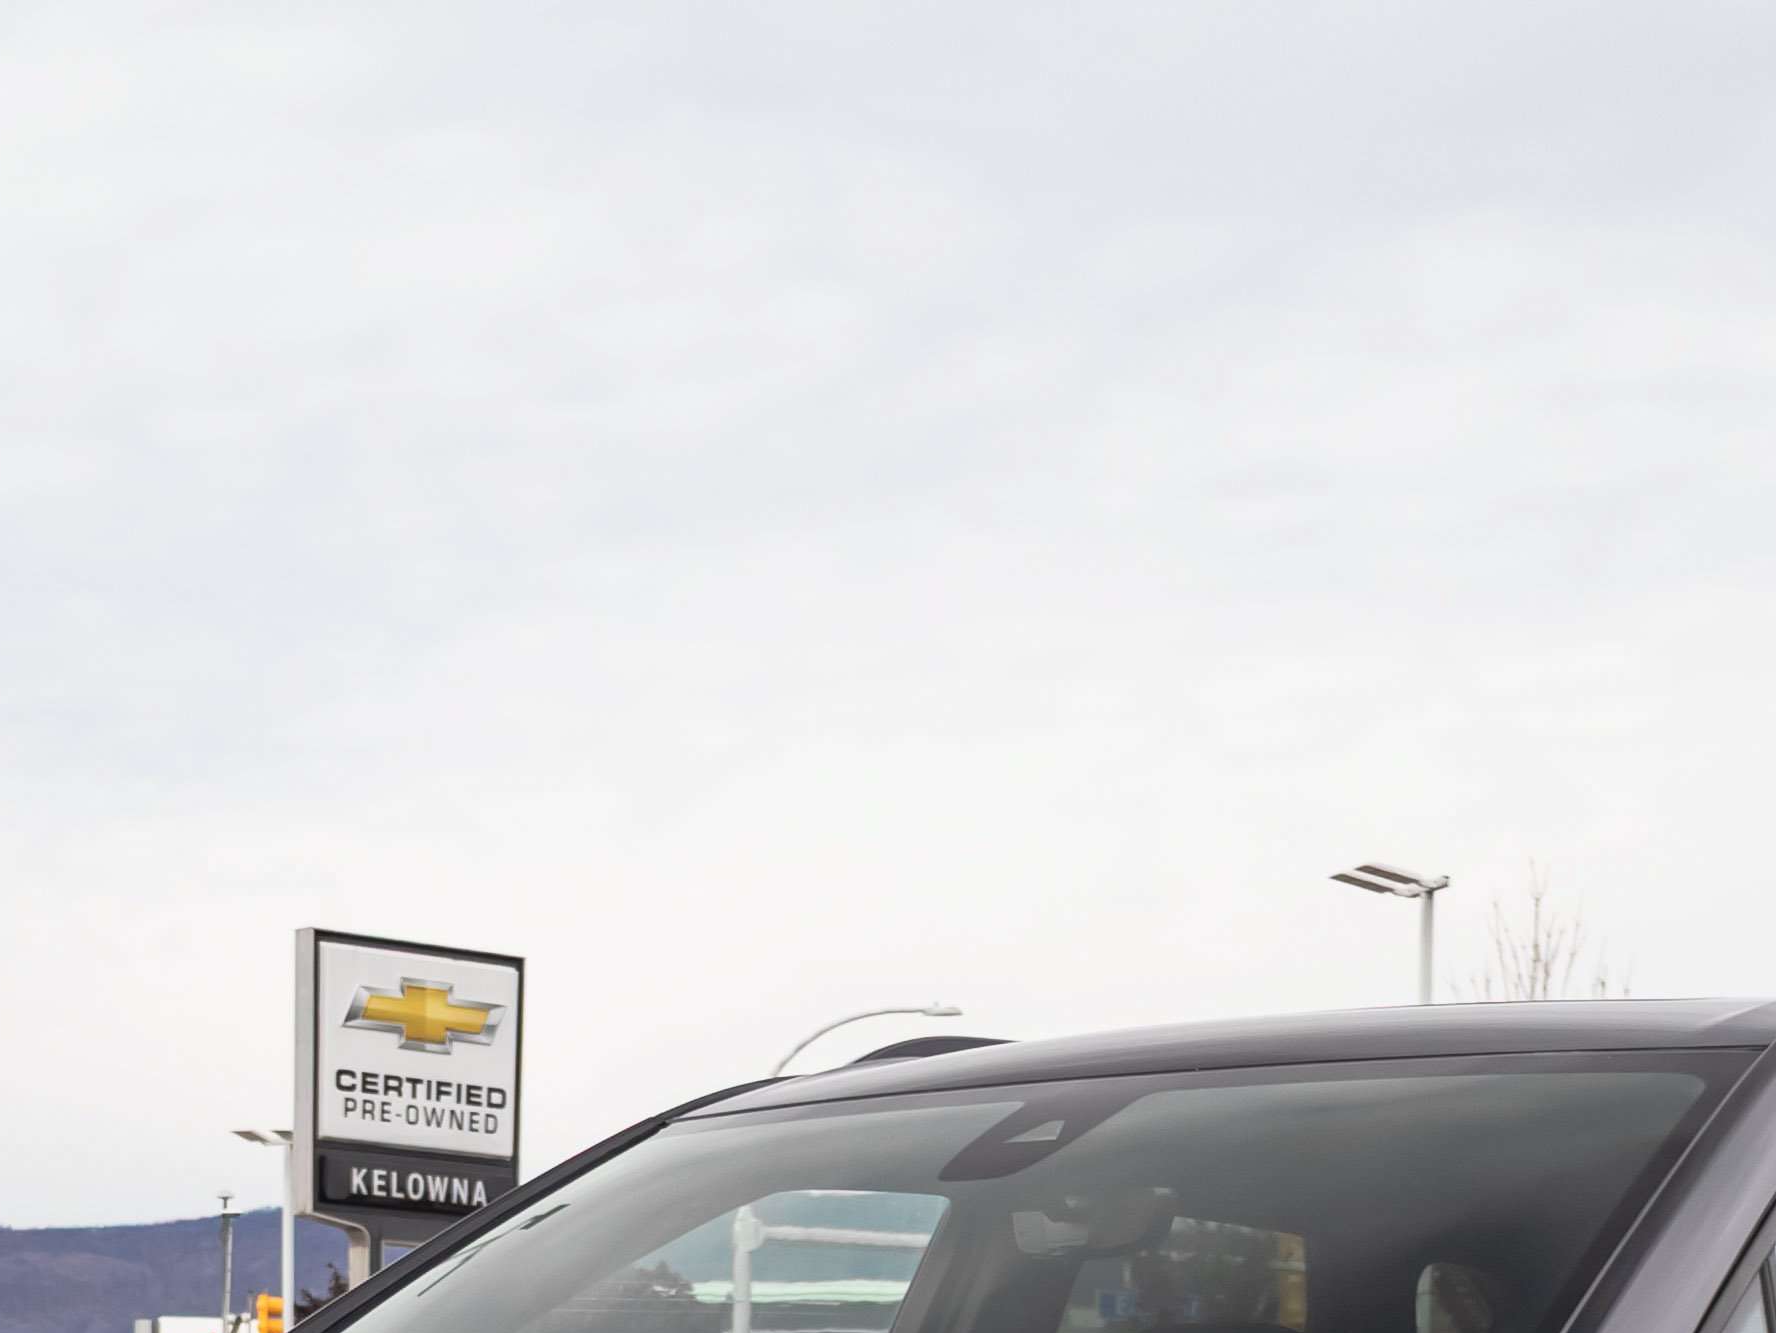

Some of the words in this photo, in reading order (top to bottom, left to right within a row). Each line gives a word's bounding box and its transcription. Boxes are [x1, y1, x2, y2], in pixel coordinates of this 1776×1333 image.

[335, 1068, 507, 1110] CERTIFIED
[344, 1097, 499, 1134] PRE-OWNED
[350, 1166, 488, 1207] KELOWNA
